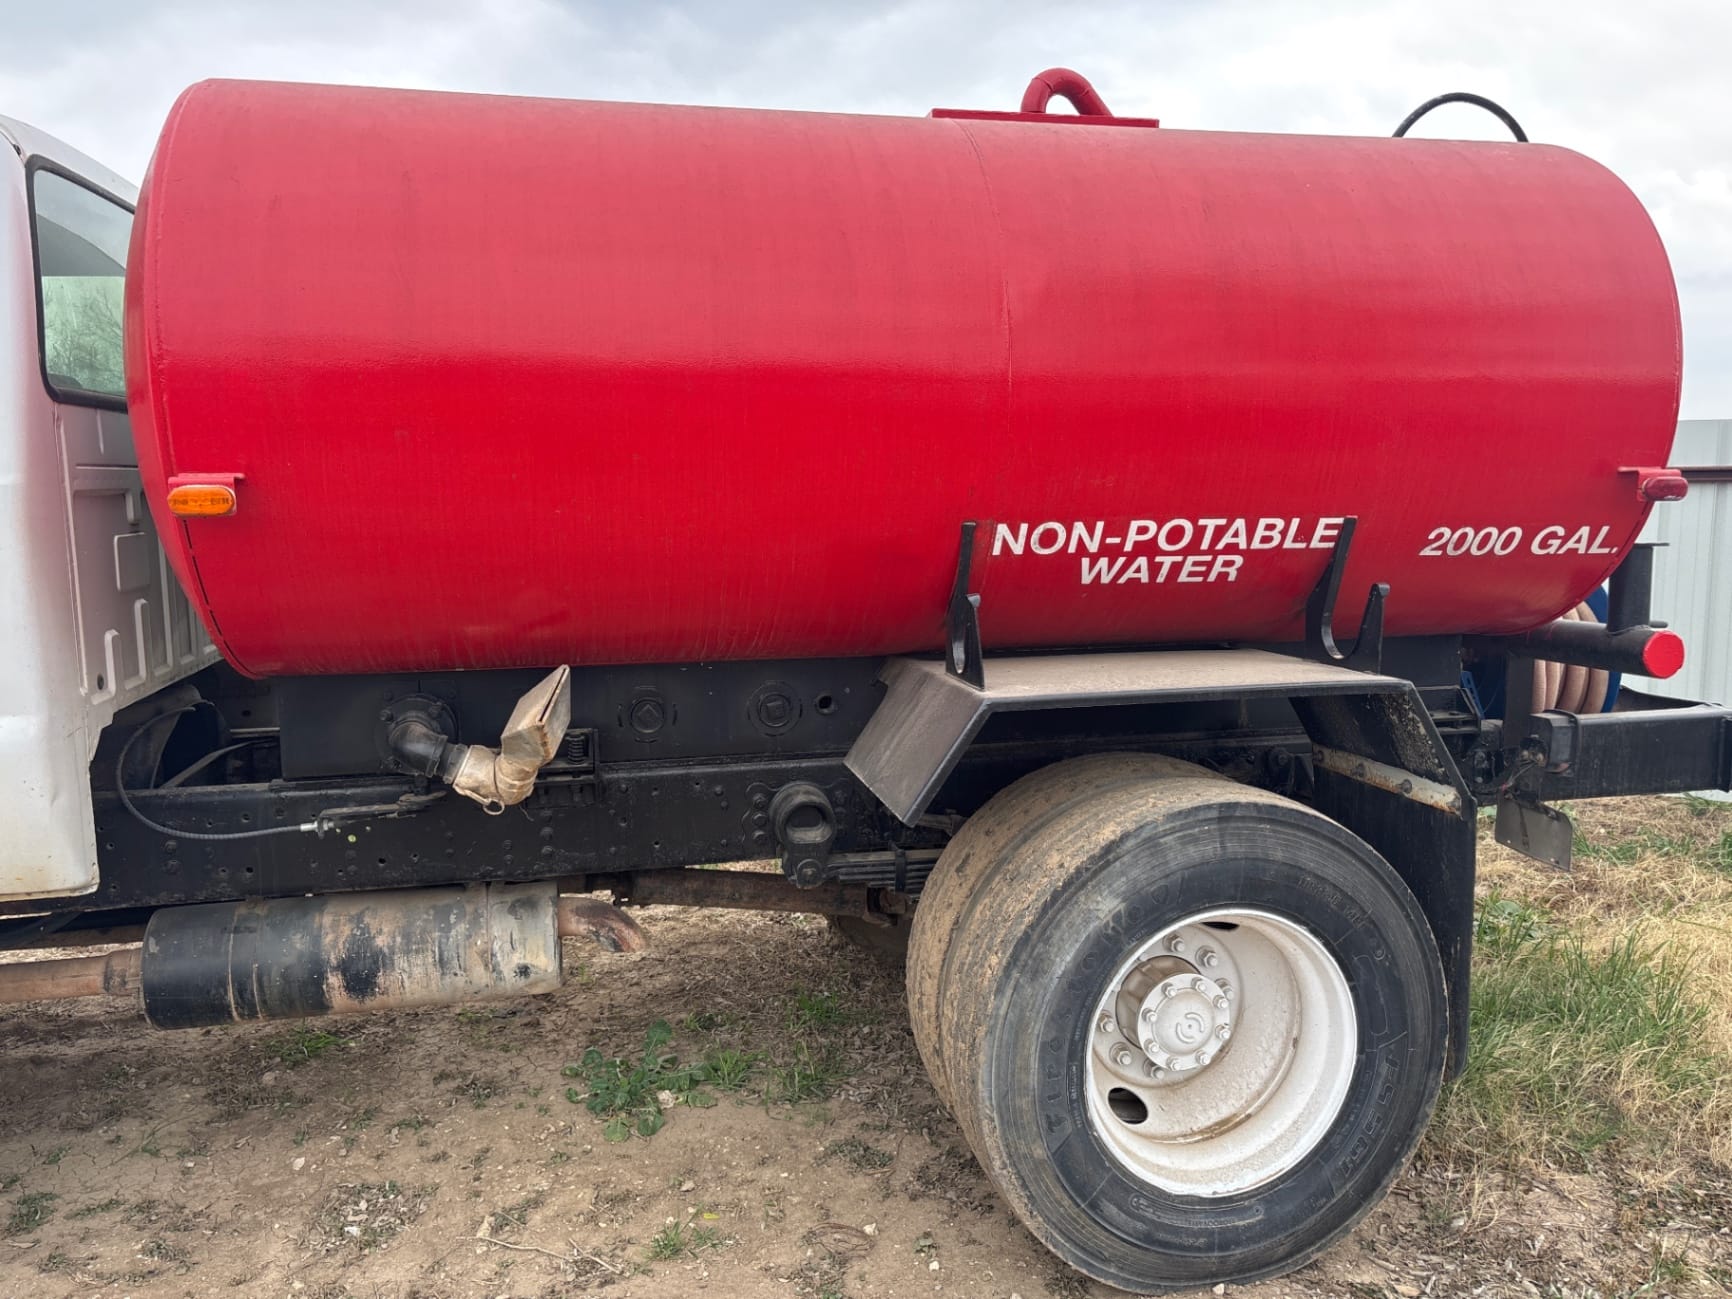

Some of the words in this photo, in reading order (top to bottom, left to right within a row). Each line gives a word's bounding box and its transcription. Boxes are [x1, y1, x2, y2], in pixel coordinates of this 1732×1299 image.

[992, 516, 1344, 556] NON-POTABLE
[1418, 526, 1523, 556] 2000
[1530, 525, 1619, 555] GAL.
[1081, 555, 1244, 585] WATER
